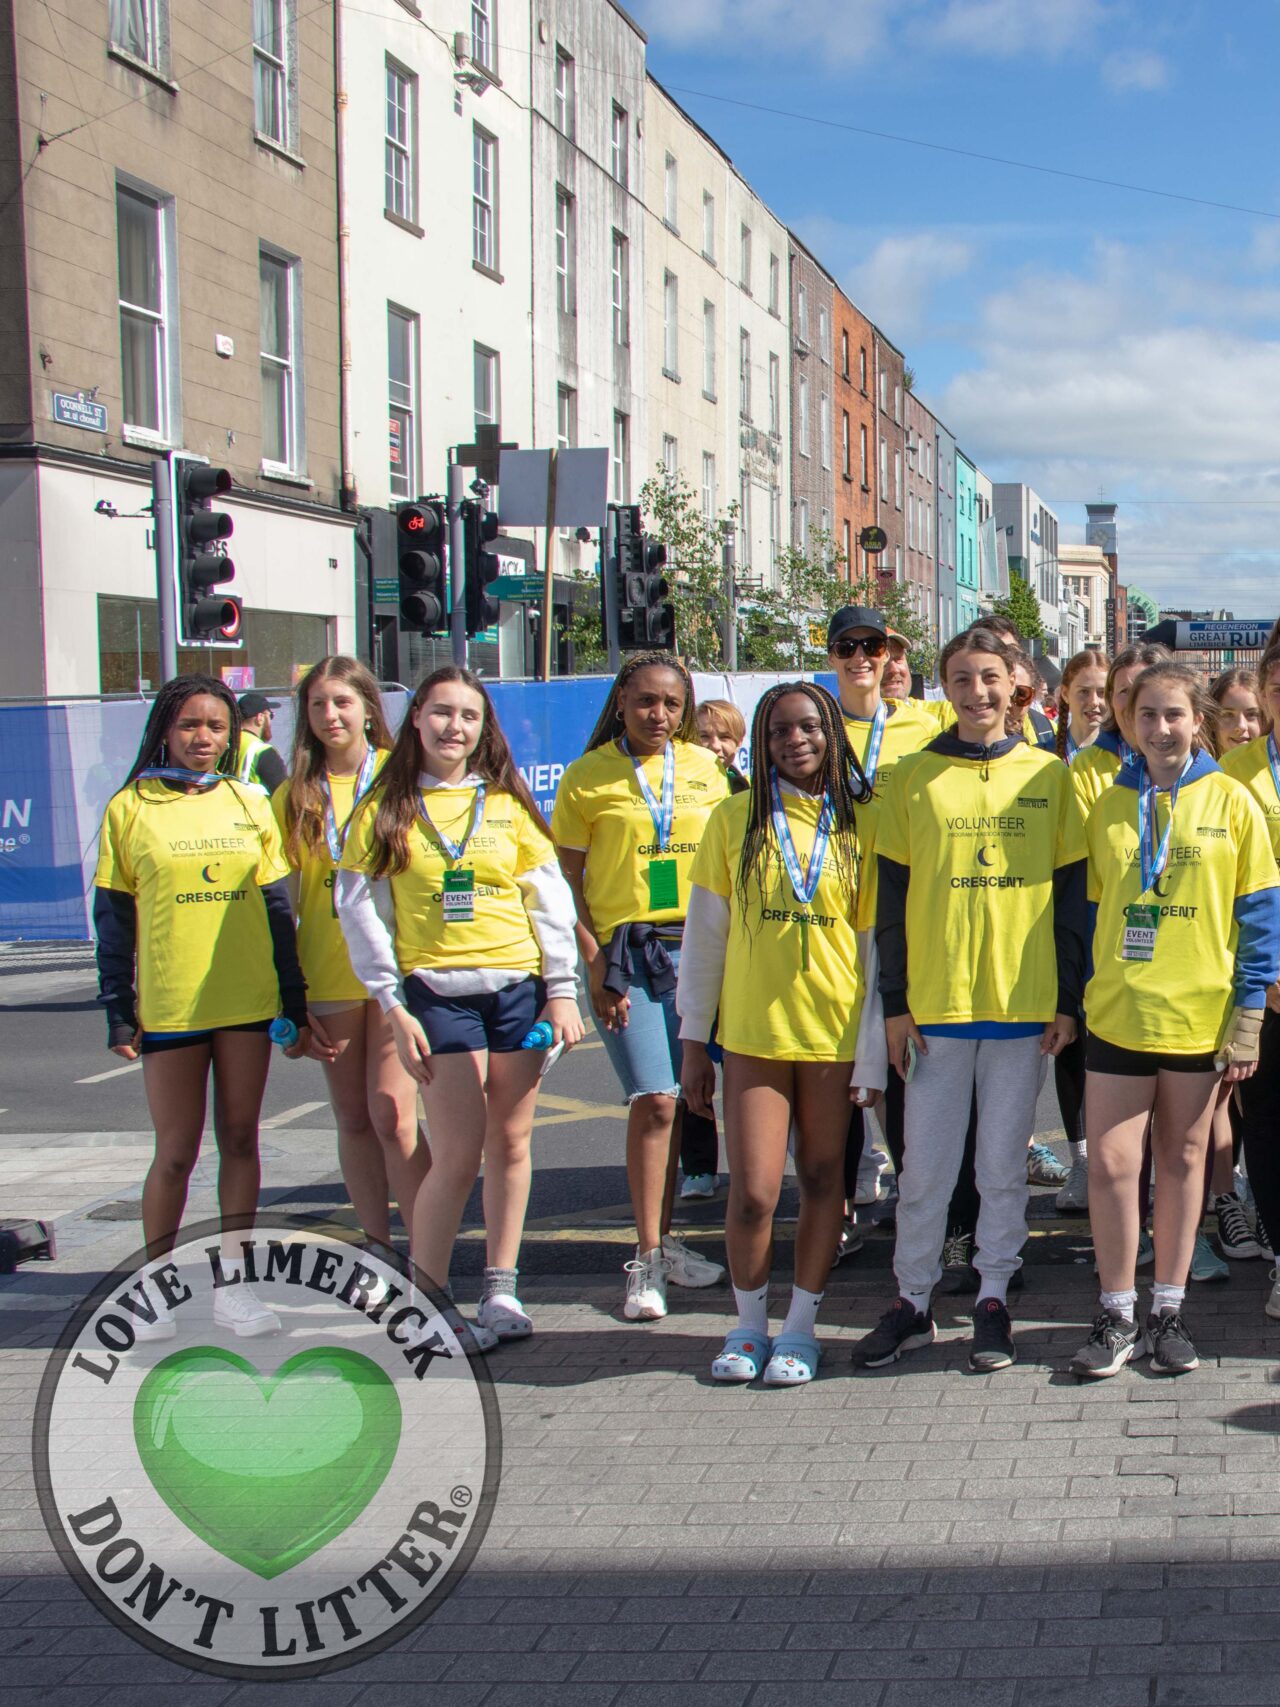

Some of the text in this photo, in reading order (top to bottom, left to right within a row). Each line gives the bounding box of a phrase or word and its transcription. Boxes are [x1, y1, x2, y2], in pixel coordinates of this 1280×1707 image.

[1189, 632, 1227, 642] GREAT
[945, 816, 1025, 830] VOLUNTEER
[168, 838, 247, 852] VOLUNTEER
[638, 843, 701, 855] CRESCEN
[950, 876, 1025, 889] CRESCENT
[175, 890, 249, 904] CRESCENT
[445, 893, 473, 902] EVENT
[1126, 929, 1155, 939] EVENT
[1125, 937, 1154, 945] VOLUNTEER
